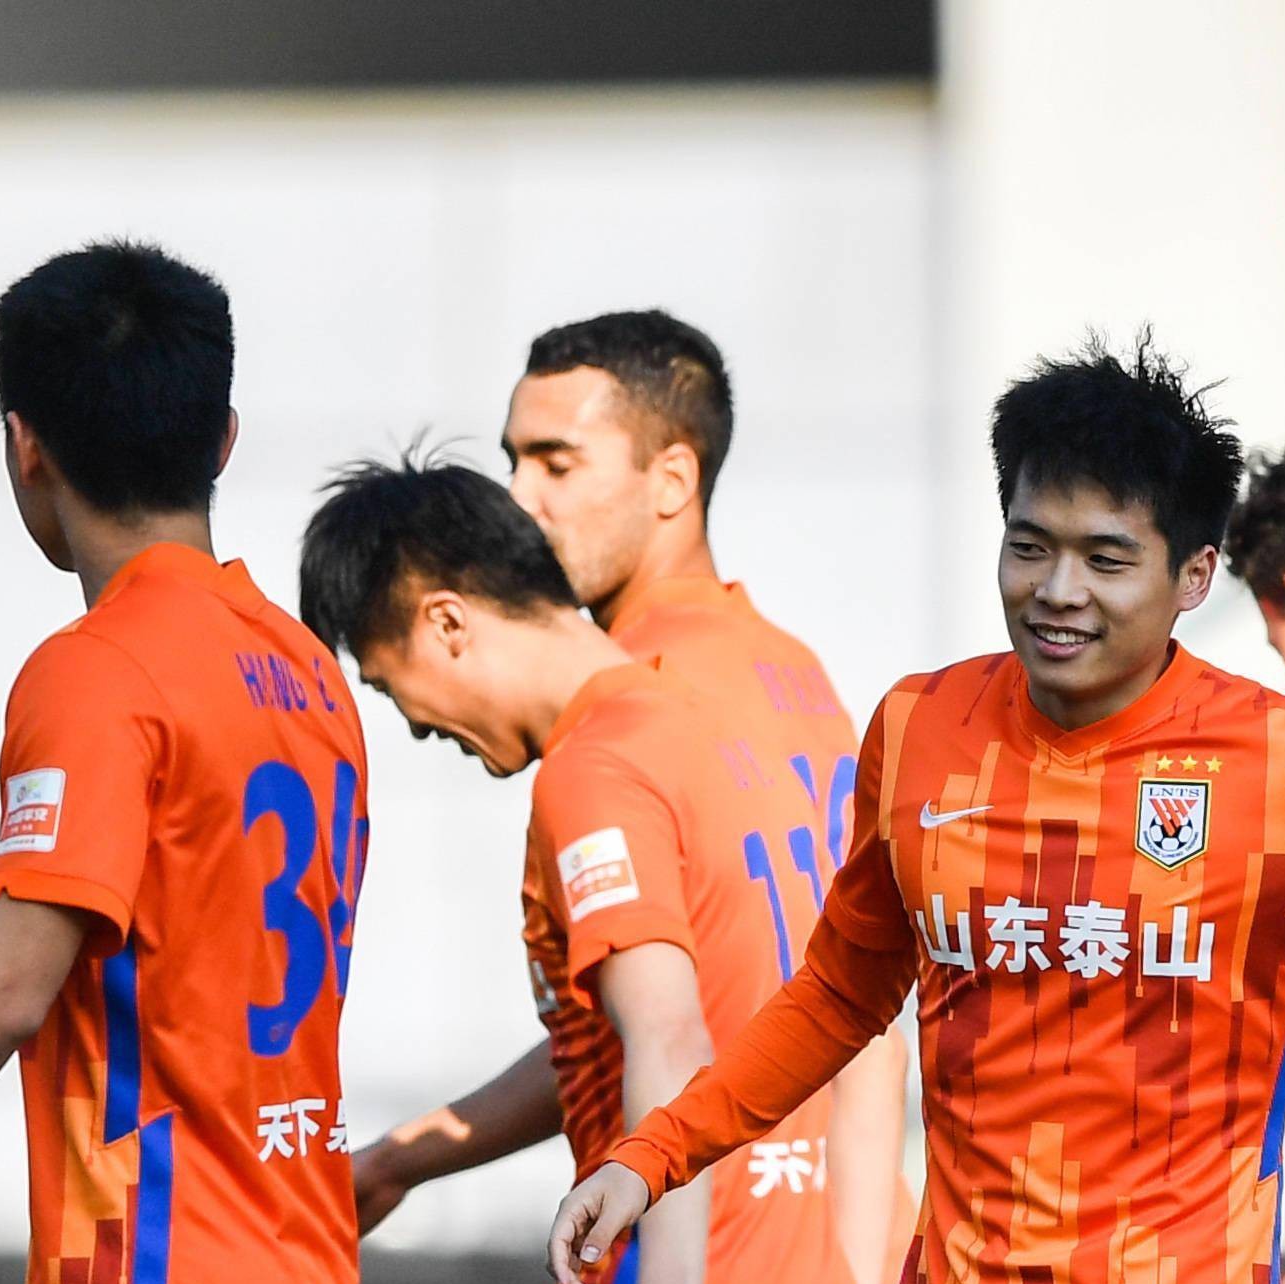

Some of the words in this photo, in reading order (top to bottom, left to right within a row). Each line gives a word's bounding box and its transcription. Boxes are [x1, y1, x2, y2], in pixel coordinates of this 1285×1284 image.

[1148, 786, 1201, 798] LNTS
[243, 758, 371, 1058] 34
[916, 893, 1216, 982] 山东泰山
